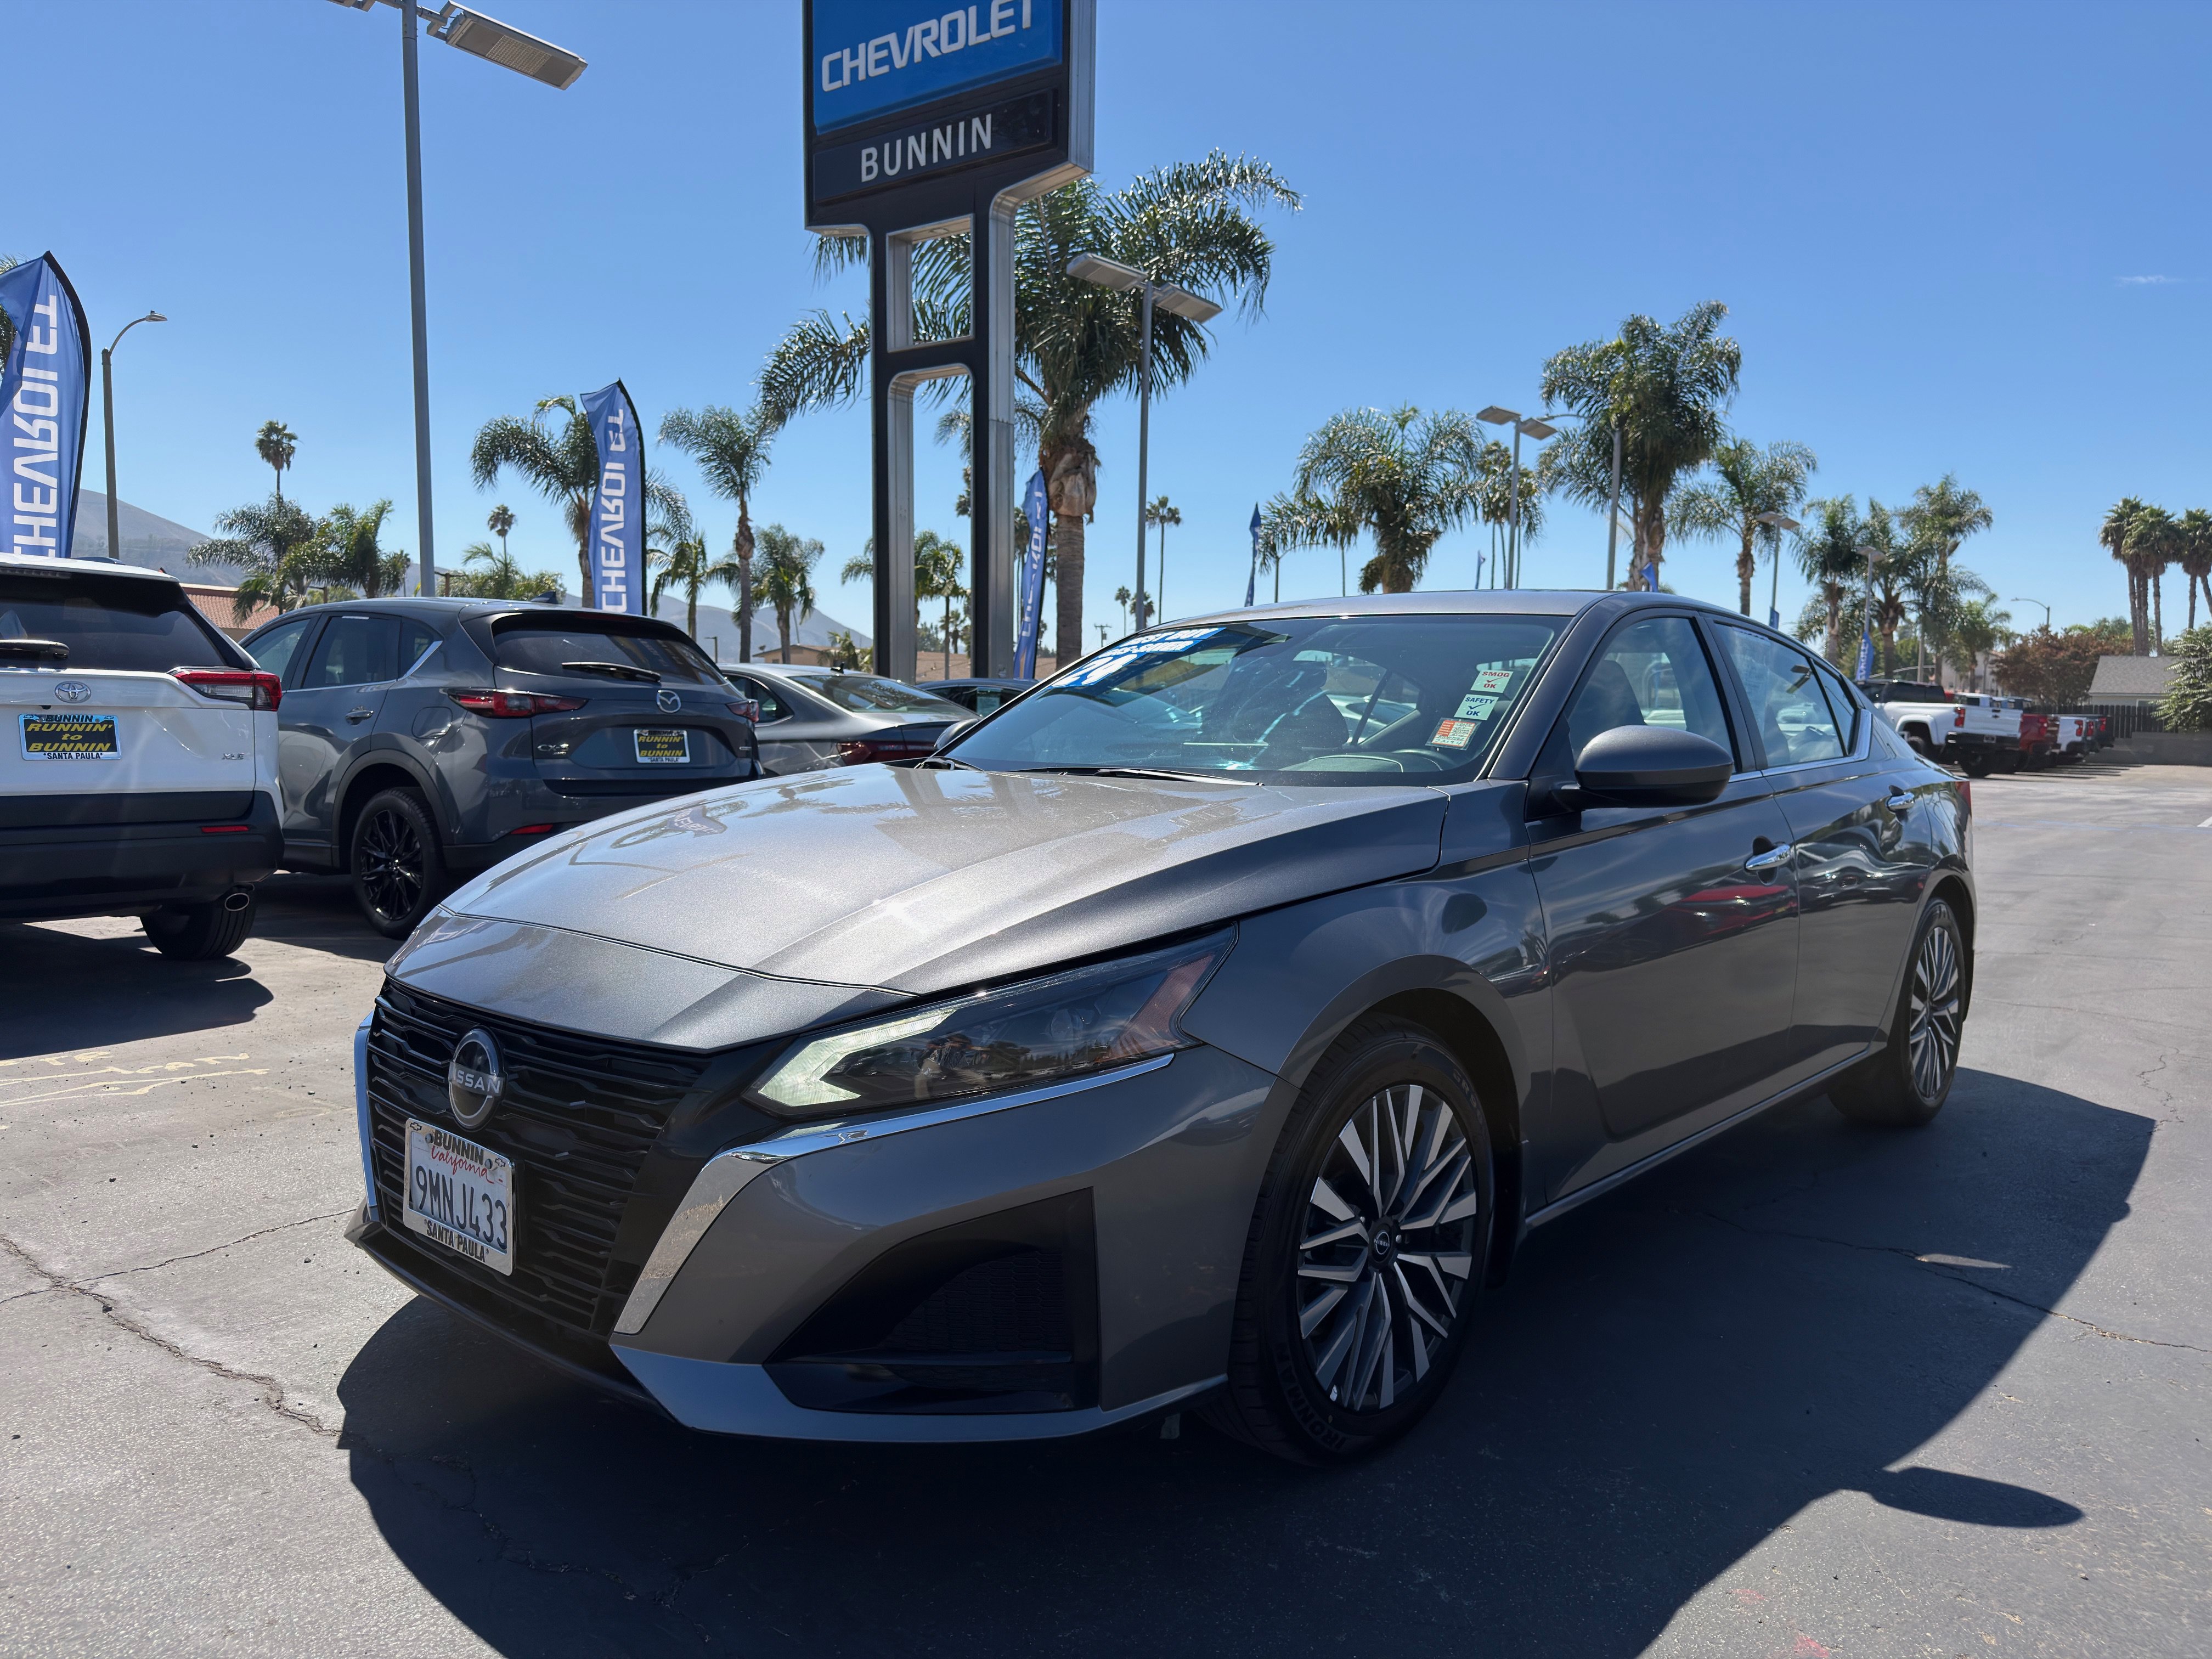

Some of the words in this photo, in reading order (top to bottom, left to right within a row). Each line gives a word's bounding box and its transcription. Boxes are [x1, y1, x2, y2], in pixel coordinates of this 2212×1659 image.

[861, 114, 992, 182] BUNNIN
[26, 723, 113, 732] RUNNIN'
[46, 714, 93, 723] BUNNIN
[28, 742, 111, 752] BUNNIN
[454, 1069, 501, 1094] SSAN
[431, 1145, 495, 1184] California
[434, 1129, 484, 1166] BUNNIN
[416, 1165, 507, 1250] 9MNJ433
[427, 1220, 454, 1248] SANTA
[457, 1234, 486, 1262] PAULA
